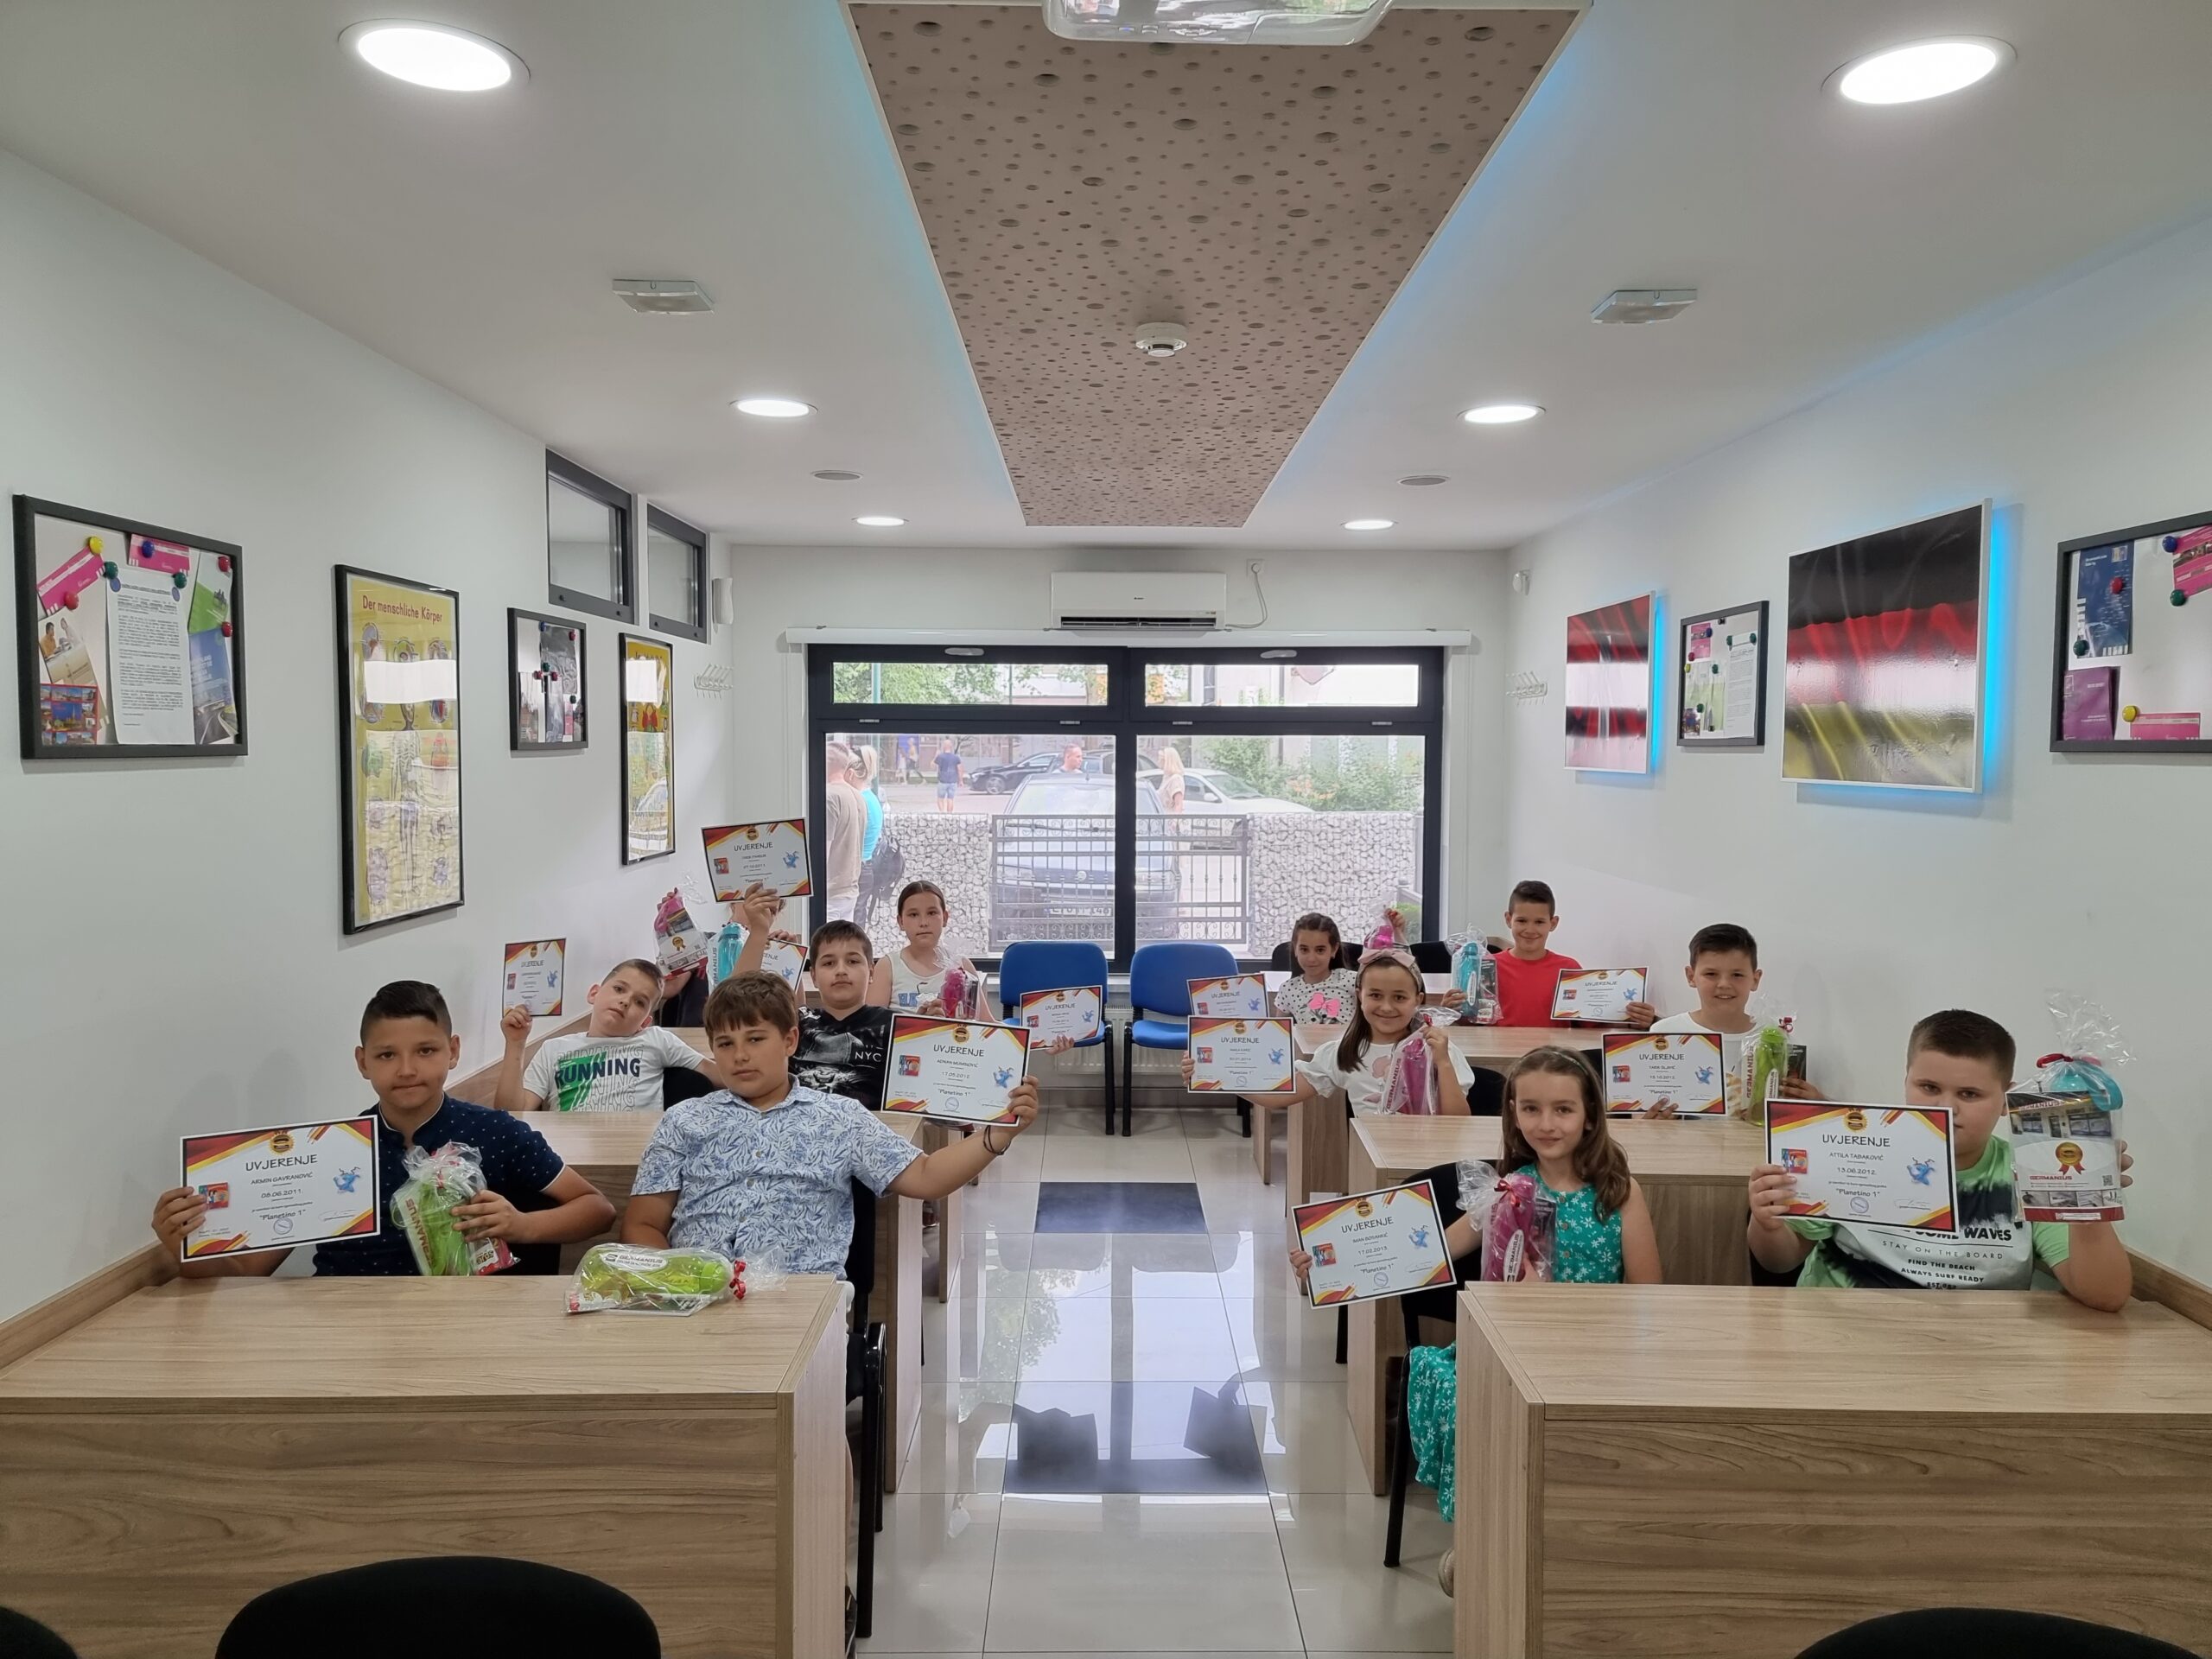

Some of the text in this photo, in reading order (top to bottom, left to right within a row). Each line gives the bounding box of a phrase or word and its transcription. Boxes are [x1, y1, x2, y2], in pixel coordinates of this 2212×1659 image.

[363, 595, 442, 625] Der menschliche Körper
[734, 842, 773, 852] UVJERENJE
[855, 1051, 882, 1062] NYC
[933, 1044, 985, 1057] UVJERENJE
[555, 1058, 640, 1089] RUNNING
[1386, 1058, 1402, 1109] GERMANIUS
[1822, 1134, 1891, 1147] UVJERENJE
[245, 1154, 318, 1172] UVJERENJE
[1341, 1216, 1394, 1234] UVJERENJE
[1964, 1227, 2012, 1242] WAVES
[1882, 1240, 1908, 1250] STAY
[1901, 1268, 1932, 1277] ALWAYS
[1958, 1274, 1985, 1283] READY
